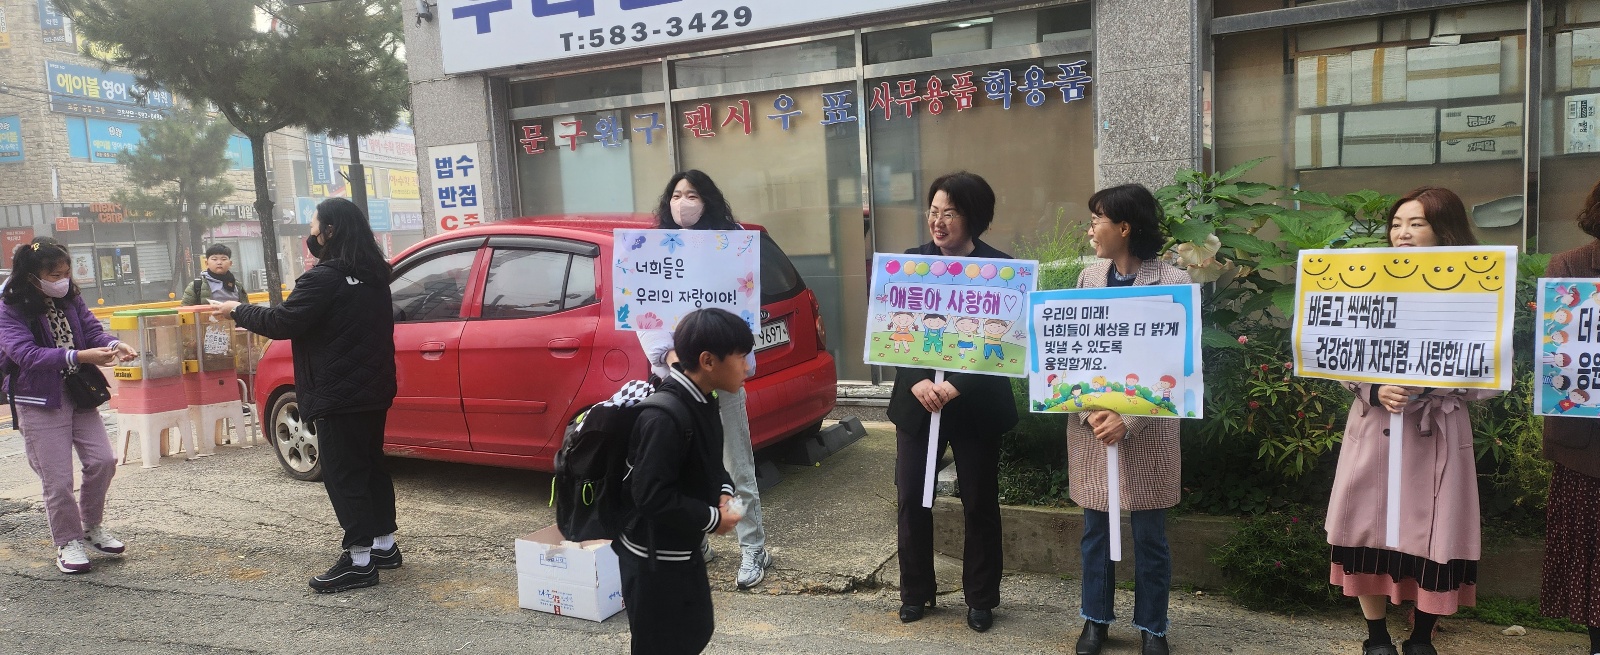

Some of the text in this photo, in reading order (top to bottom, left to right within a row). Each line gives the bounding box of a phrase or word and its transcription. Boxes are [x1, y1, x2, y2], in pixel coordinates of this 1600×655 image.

[560, 6, 753, 52] T:583-3429
[57, 73, 100, 98] 에이블
[102, 80, 126, 99] 영어
[520, 59, 1092, 155] 문구 완구 팬시 우표 사무용품 학용품
[434, 154, 475, 179] 법수
[437, 184, 478, 209] 반점
[635, 256, 685, 280] 너희들은
[635, 287, 737, 308] 우리의 자랑이야!
[946, 290, 1001, 315] 사랑해
[1042, 306, 1109, 321] 우리의 미래!
[1307, 295, 1398, 329] 바르고 씩씩하고
[1043, 321, 1180, 338] 너희들이 세상을 더 밝게
[1577, 307, 1594, 344] 더
[1044, 340, 1123, 354] 빛낼 수 있도록
[1315, 336, 1366, 372] 건강하게
[1415, 340, 1489, 378] 사랑합니다.
[1044, 357, 1107, 371] 응원할게요.
